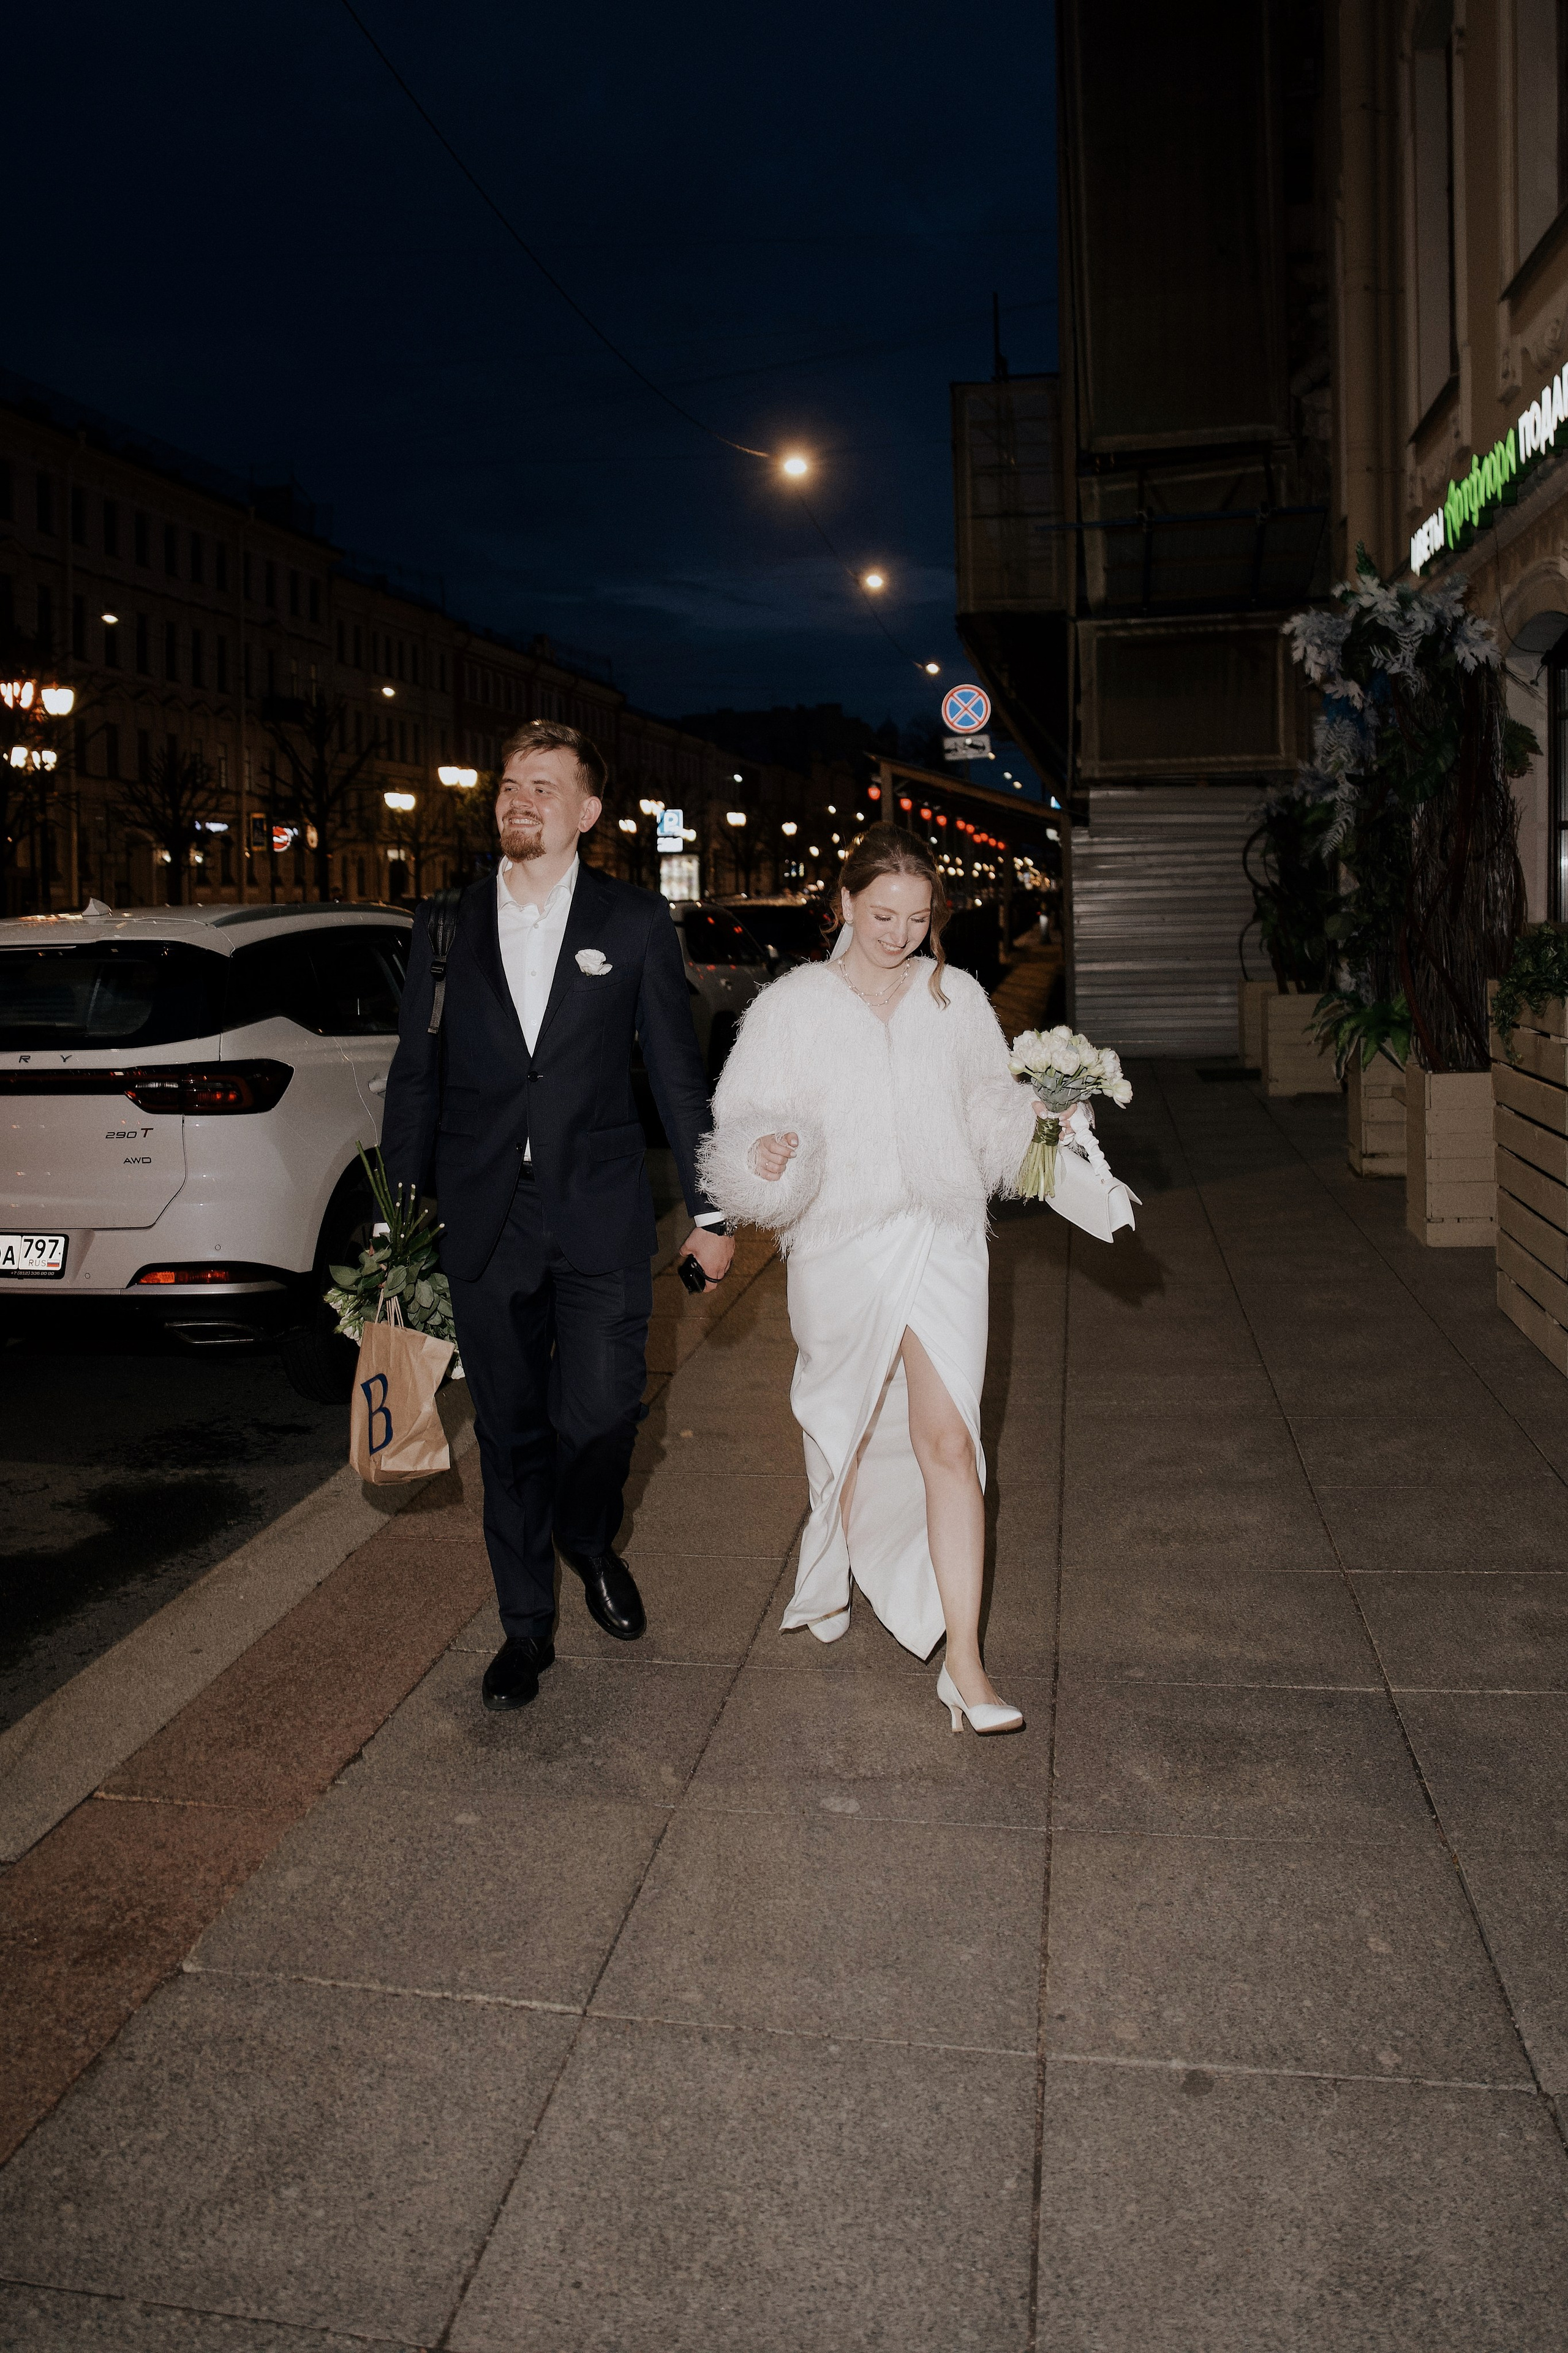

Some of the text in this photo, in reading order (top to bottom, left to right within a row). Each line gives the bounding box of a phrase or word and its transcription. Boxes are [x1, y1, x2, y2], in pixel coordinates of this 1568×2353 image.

[1411, 507, 1444, 577] ЦВЕТЫ
[0, 1238, 59, 1265] A 797
